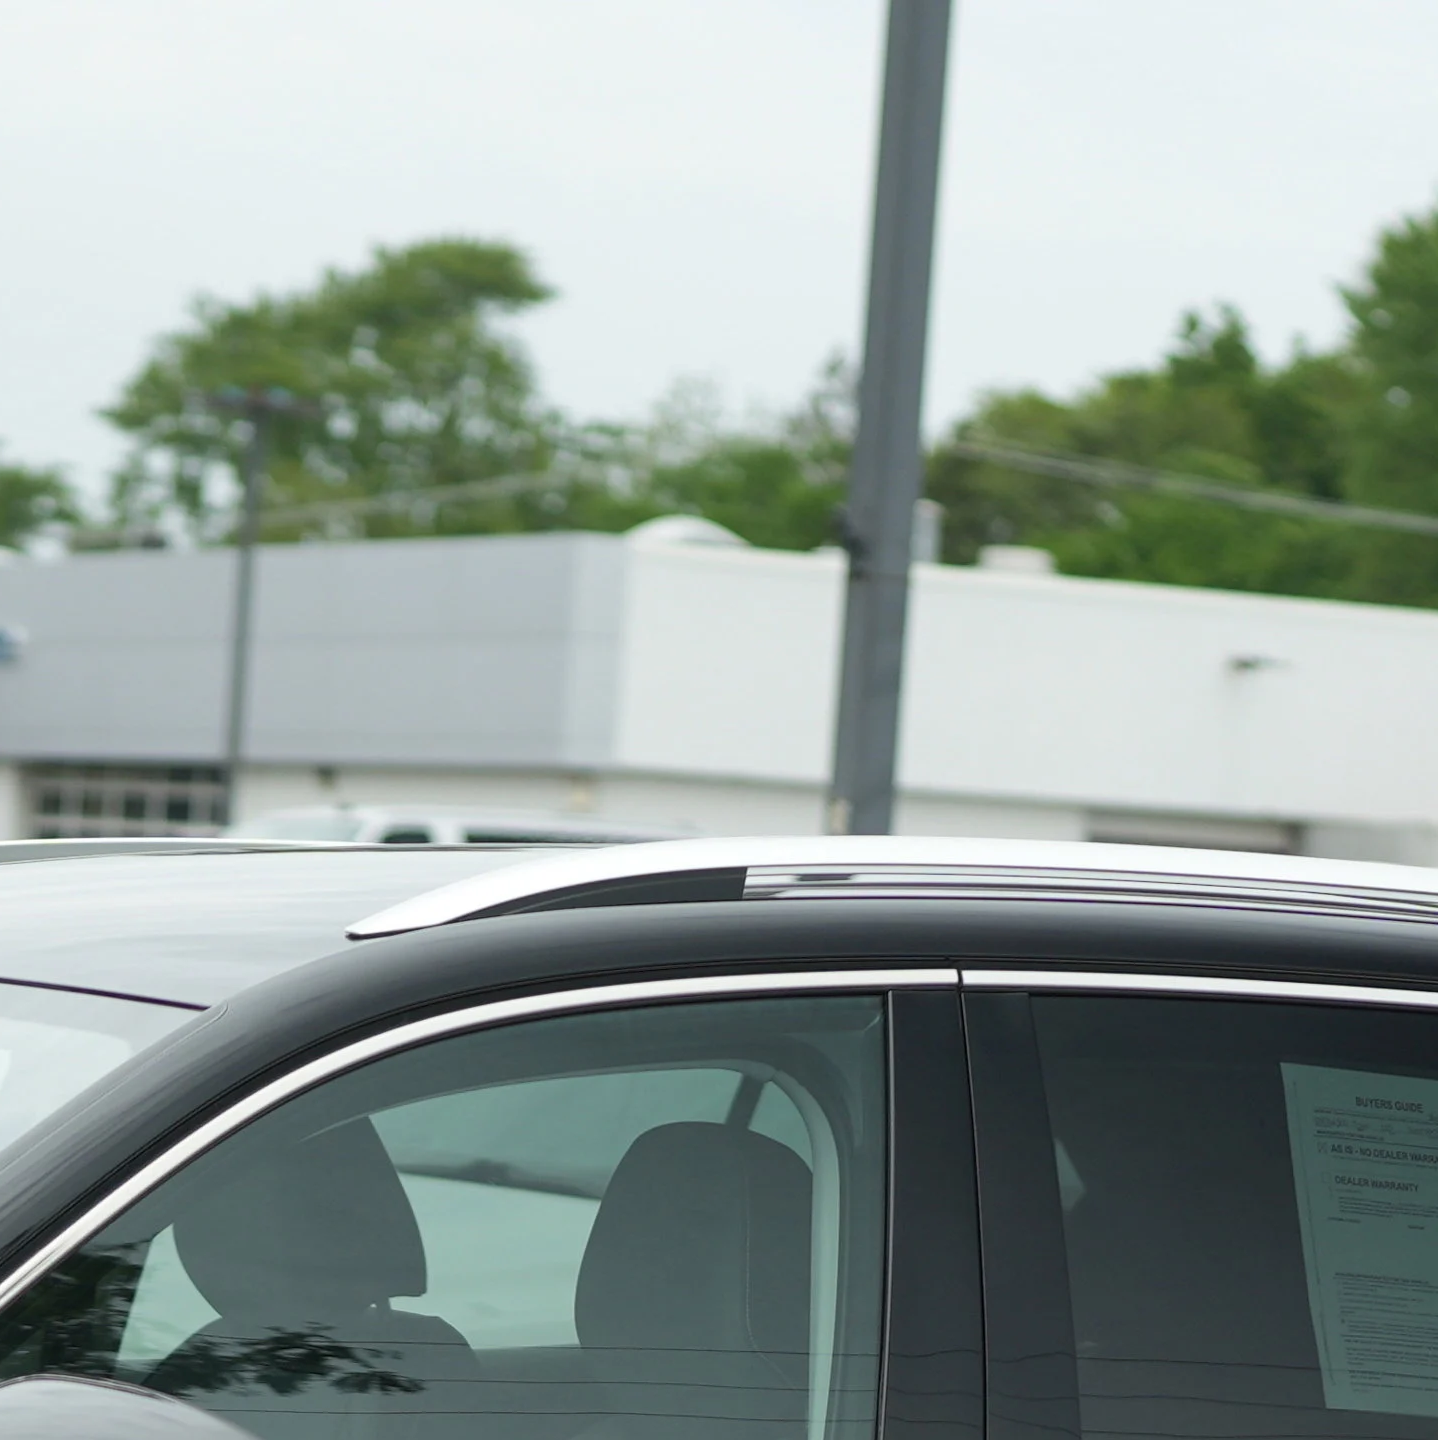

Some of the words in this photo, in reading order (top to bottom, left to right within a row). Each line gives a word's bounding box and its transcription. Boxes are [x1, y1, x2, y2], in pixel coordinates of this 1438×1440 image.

[1355, 1096, 1393, 1111] BUYERS
[1394, 1101, 1424, 1113] GUIDE
[1330, 1144, 1342, 1153] AS
[1359, 1147, 1371, 1157] NO
[1372, 1149, 1409, 1161] DEALER
[1334, 1175, 1369, 1188] DEALER
[1370, 1180, 1419, 1193] WARRANTY
